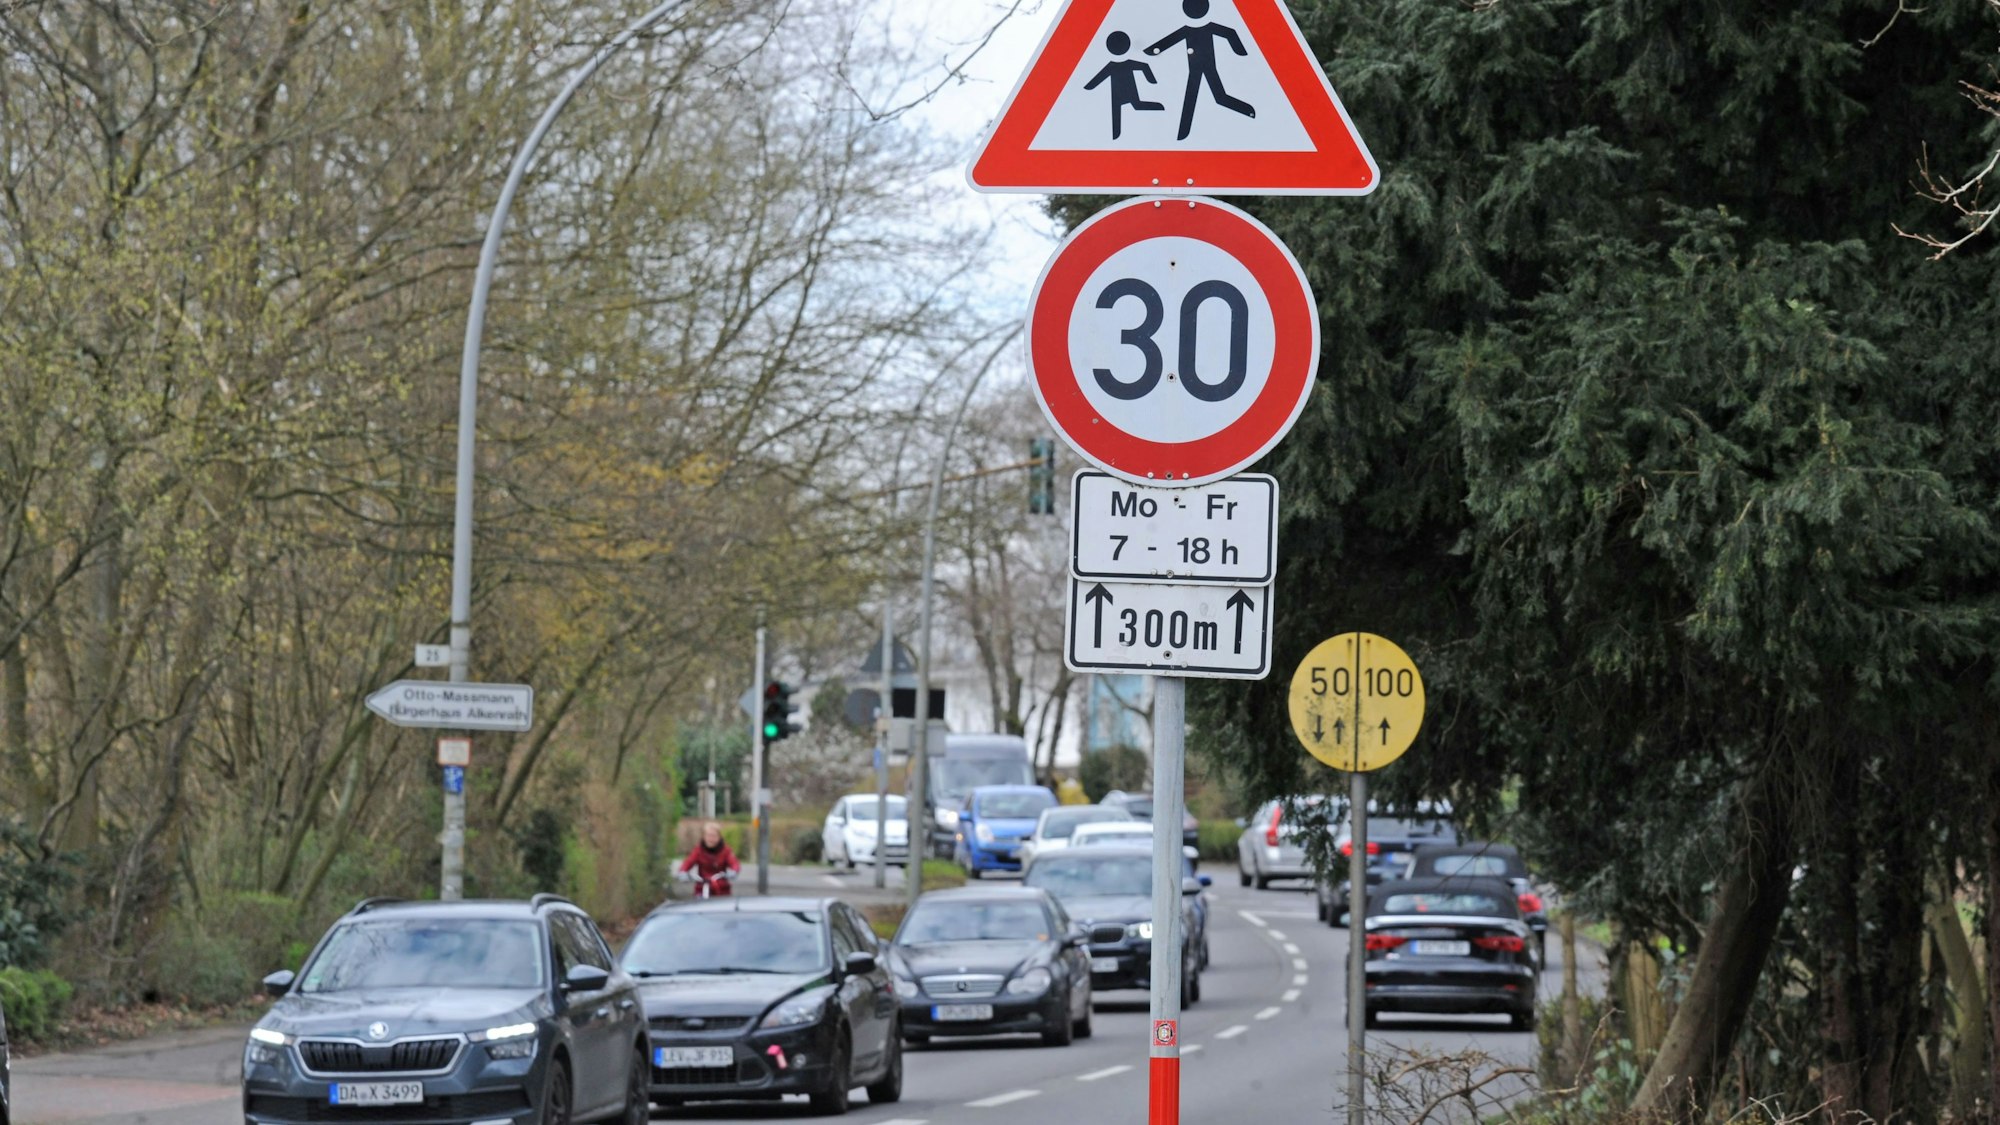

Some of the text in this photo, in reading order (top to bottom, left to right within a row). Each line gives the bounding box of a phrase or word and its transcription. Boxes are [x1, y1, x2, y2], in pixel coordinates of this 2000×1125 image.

[1092, 277, 1249, 402] 30
[1111, 491, 1158, 518] Mo
[1207, 494, 1238, 520] Fr
[1109, 535, 1128, 561] 7
[1177, 537, 1211, 564] 18
[1221, 539, 1238, 565] h
[1118, 608, 1218, 651] 300m
[1311, 667, 1350, 696] 50
[1365, 668, 1413, 697] 100
[340, 1086, 358, 1100] DA
[382, 1084, 420, 1100] 3499
